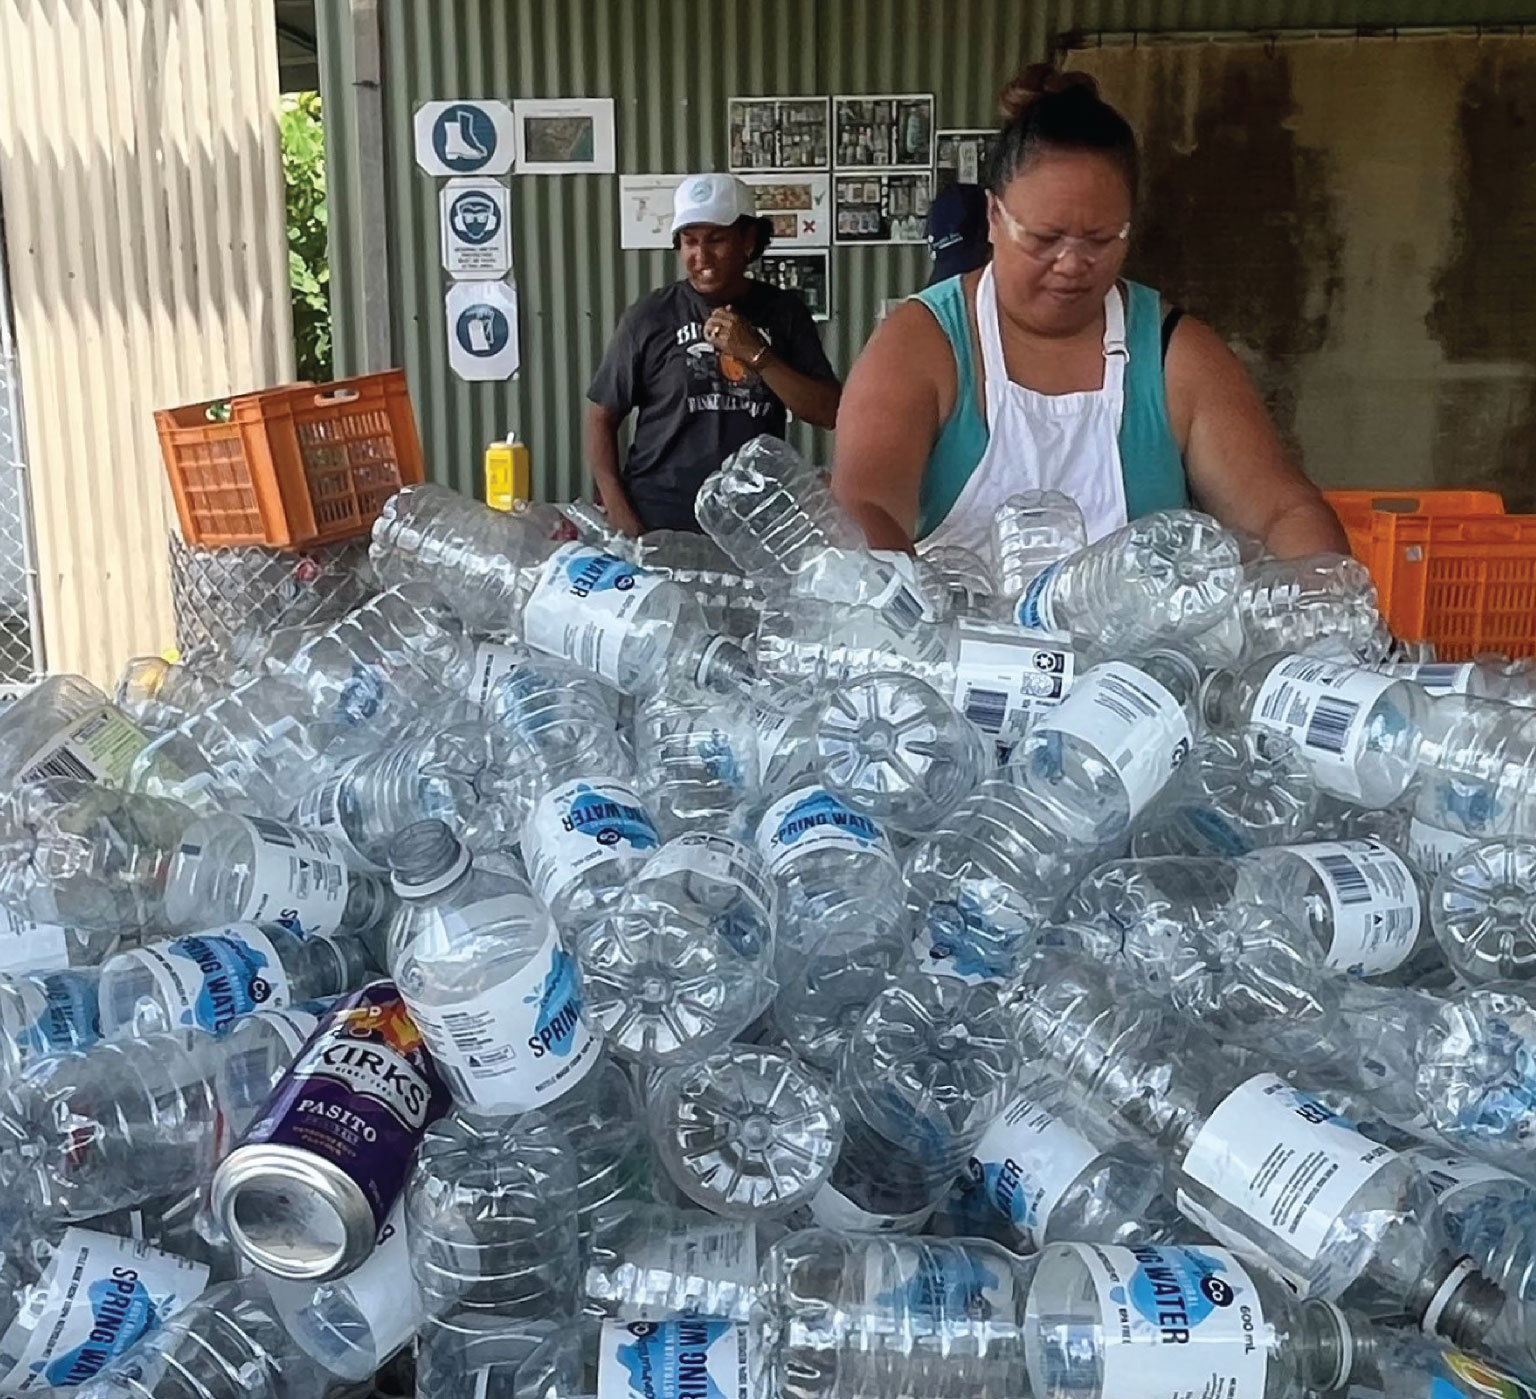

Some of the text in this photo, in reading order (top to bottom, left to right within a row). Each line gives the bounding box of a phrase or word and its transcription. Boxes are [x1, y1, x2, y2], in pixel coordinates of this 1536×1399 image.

[562, 803, 622, 832] WATER
[207, 975, 236, 1031] WATE
[529, 999, 578, 1058] SPRIN
[297, 1099, 377, 1142] PASITO
[61, 1266, 138, 1387] SPRING WAT
[1145, 1266, 1189, 1344] WATER
[1240, 1304, 1256, 1354] 600 mL
[678, 1351, 708, 1399] RING
